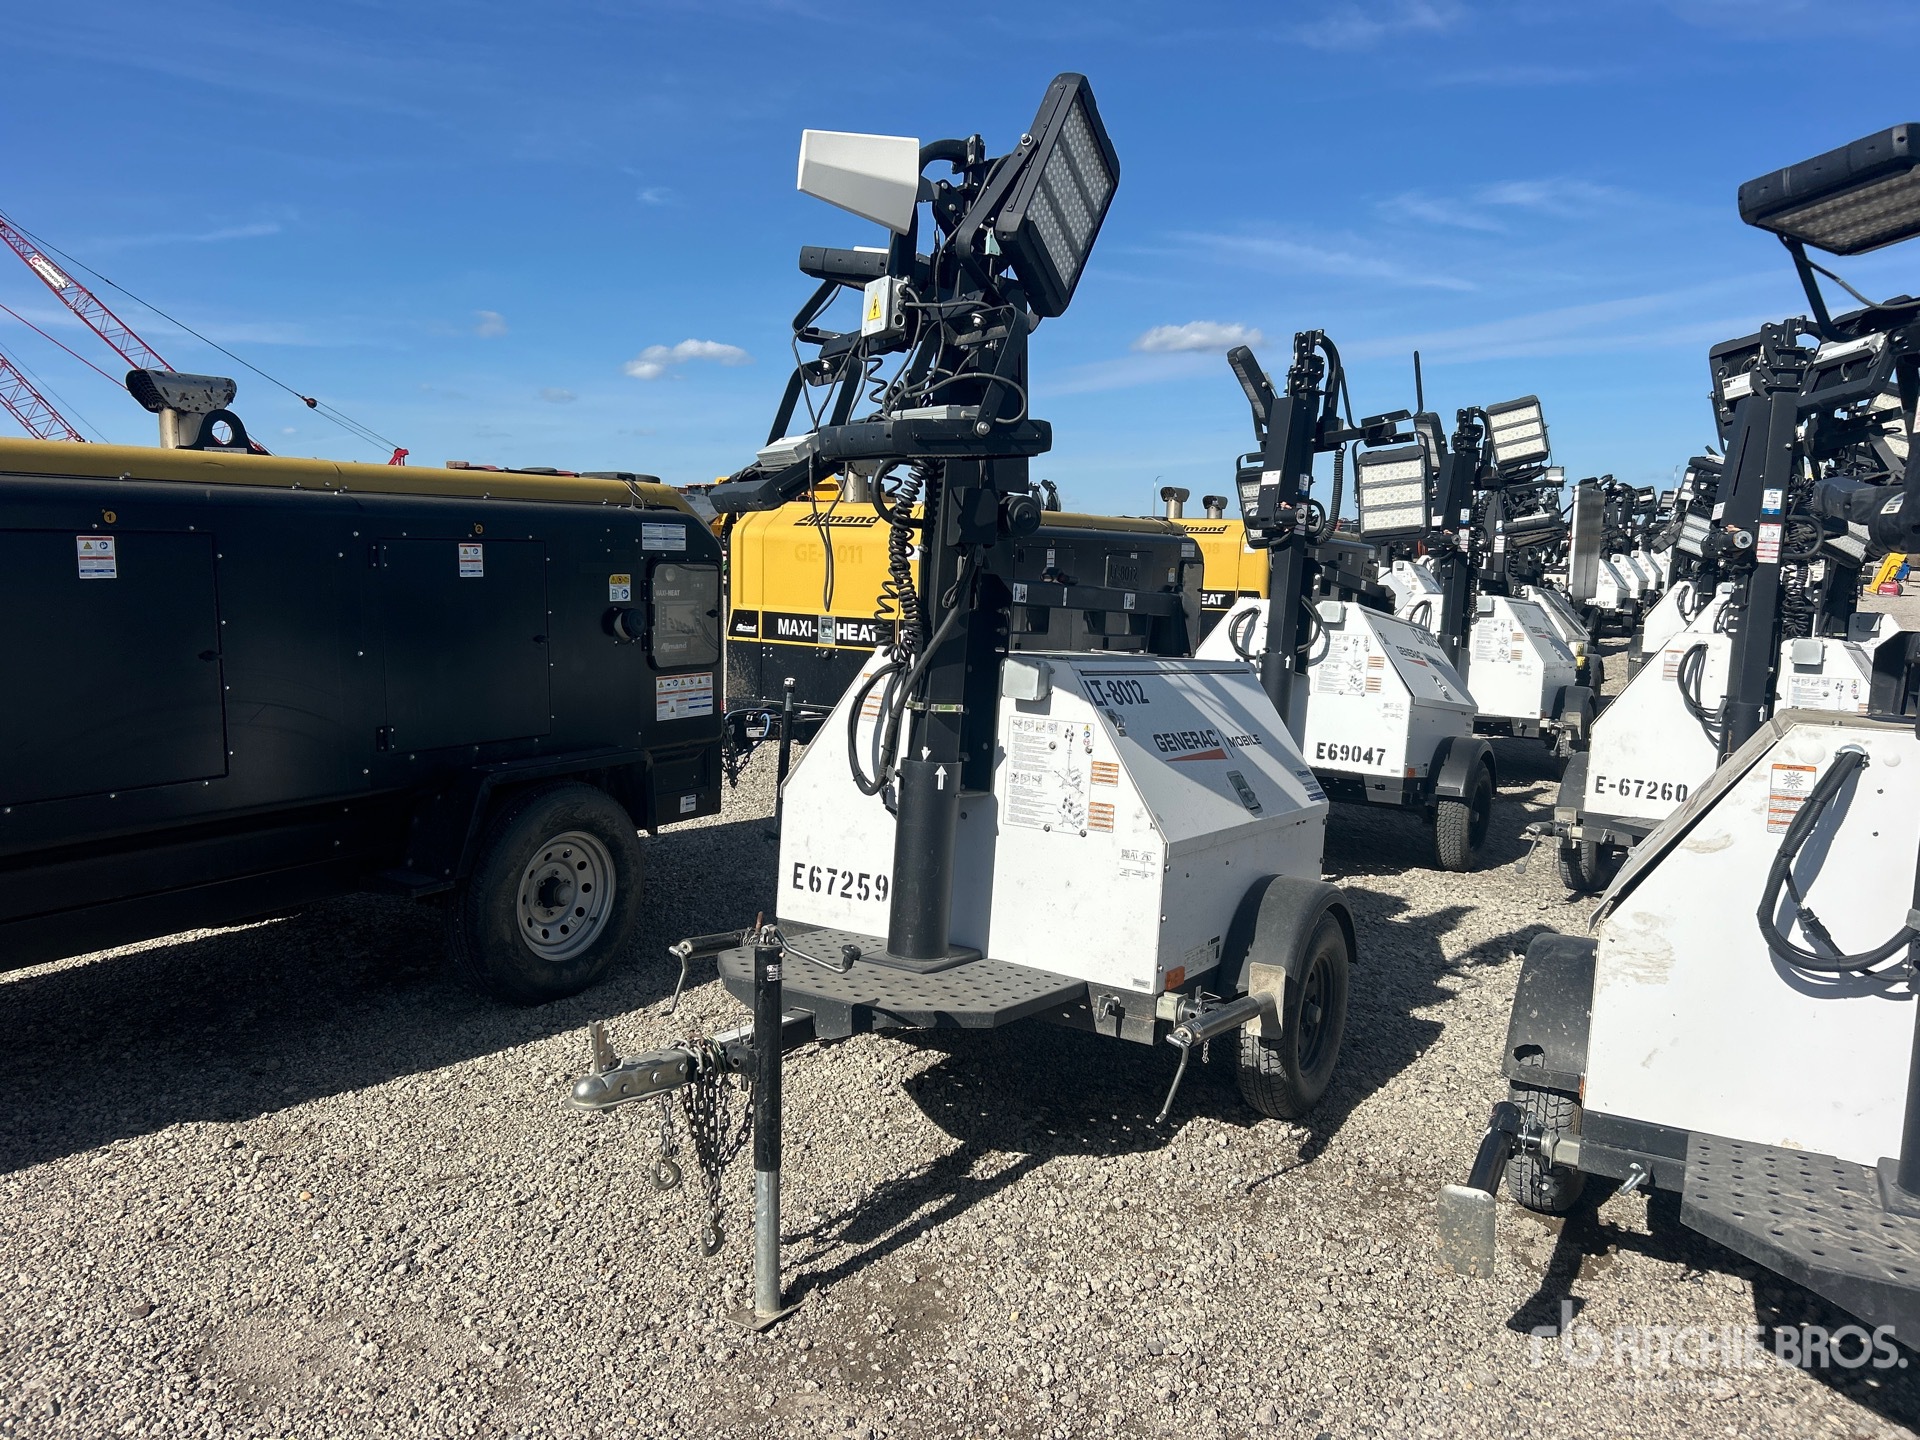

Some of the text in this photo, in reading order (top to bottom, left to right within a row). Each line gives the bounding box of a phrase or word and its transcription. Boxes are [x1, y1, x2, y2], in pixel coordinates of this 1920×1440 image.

[797, 512, 881, 527] Allmand
[794, 543, 863, 564] GE-011
[1202, 594, 1223, 605] EAT
[836, 623, 878, 642] HEAT
[1083, 679, 1150, 706] LT-8012
[1153, 729, 1262, 752] GENERAC MOBILE
[1316, 742, 1386, 766] E69047
[1595, 775, 1688, 802] E-67260
[793, 862, 889, 902] E67259
